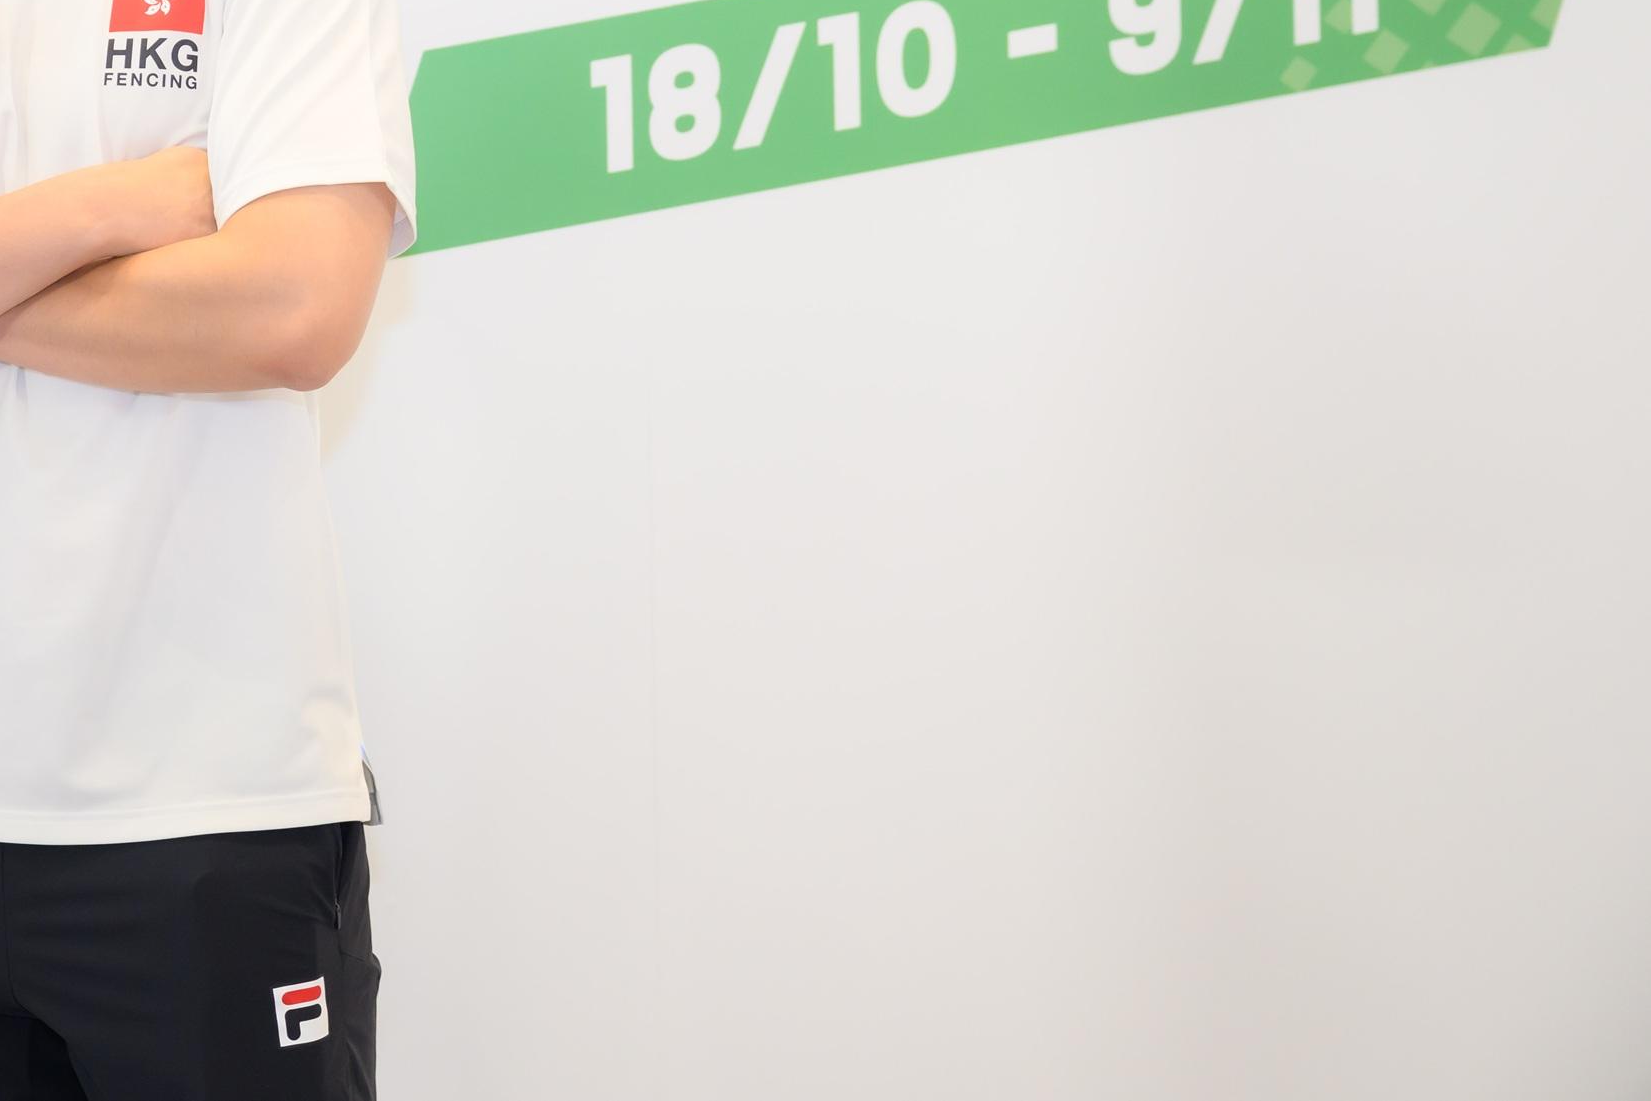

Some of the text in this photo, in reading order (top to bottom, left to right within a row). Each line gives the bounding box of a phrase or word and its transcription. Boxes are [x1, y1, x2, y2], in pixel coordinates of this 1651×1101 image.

[104, 37, 199, 73] HKG
[1006, 22, 1059, 61] -
[103, 72, 198, 90] FENCING
